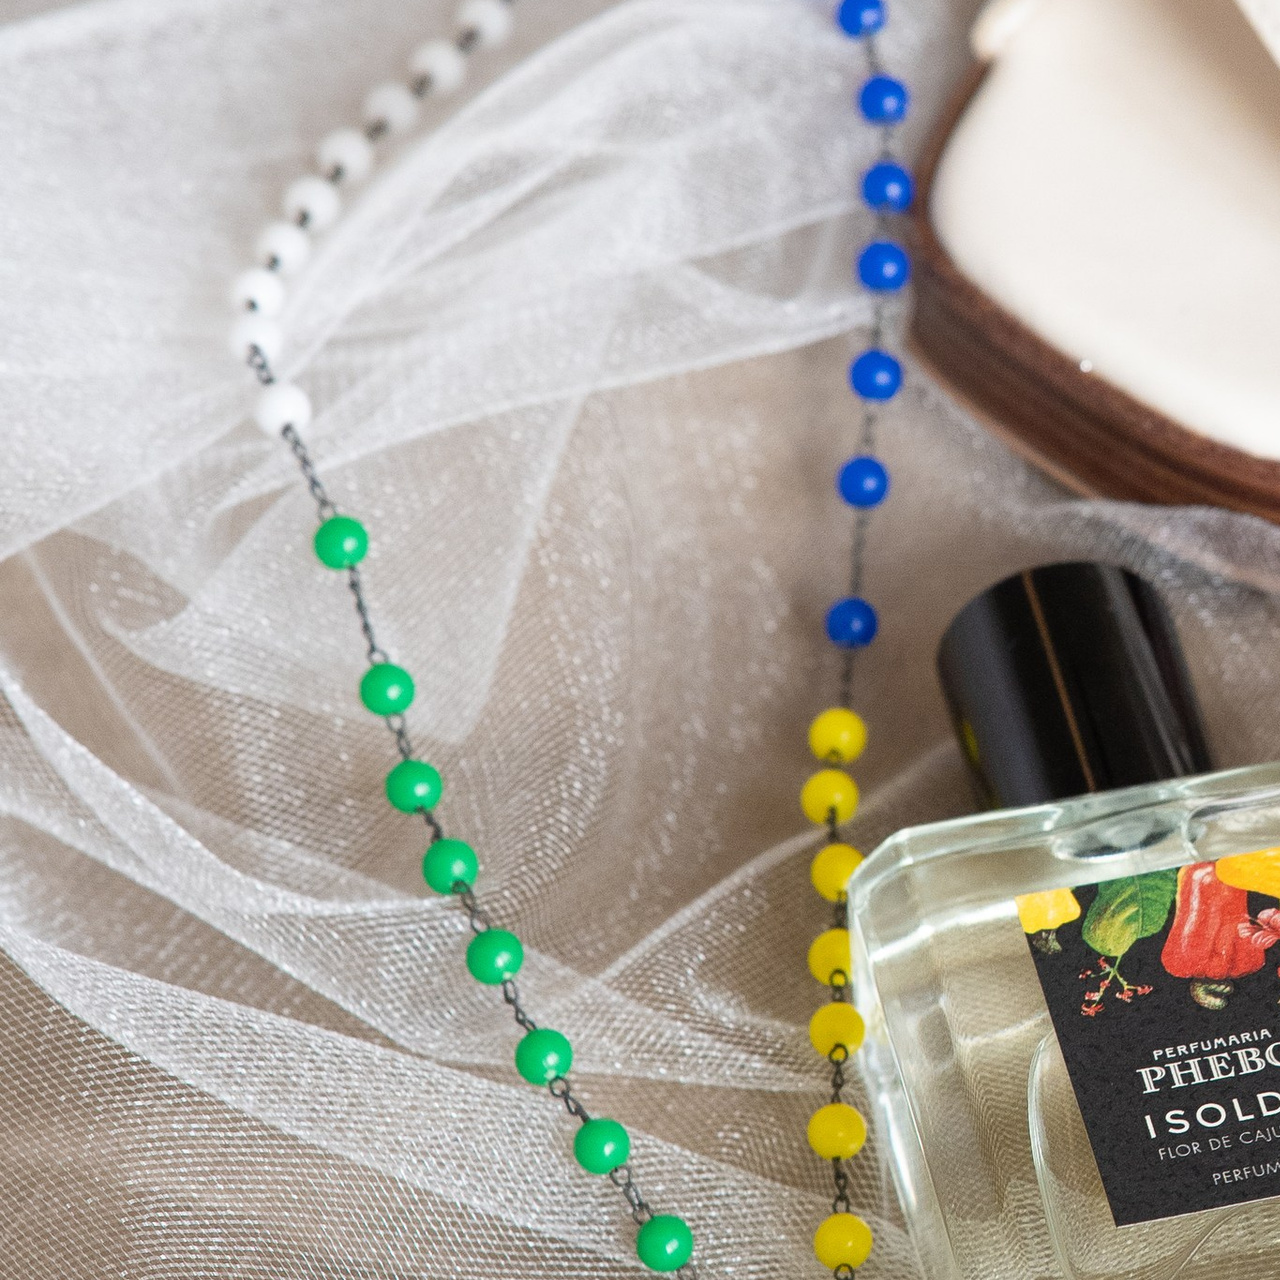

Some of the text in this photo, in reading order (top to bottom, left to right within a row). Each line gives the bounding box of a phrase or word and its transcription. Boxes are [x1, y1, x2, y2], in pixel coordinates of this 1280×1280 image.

[1153, 1028, 1272, 1060] PERFUMARIA
[1158, 1142, 1202, 1160] FLOR
[1208, 1136, 1232, 1151] DE
